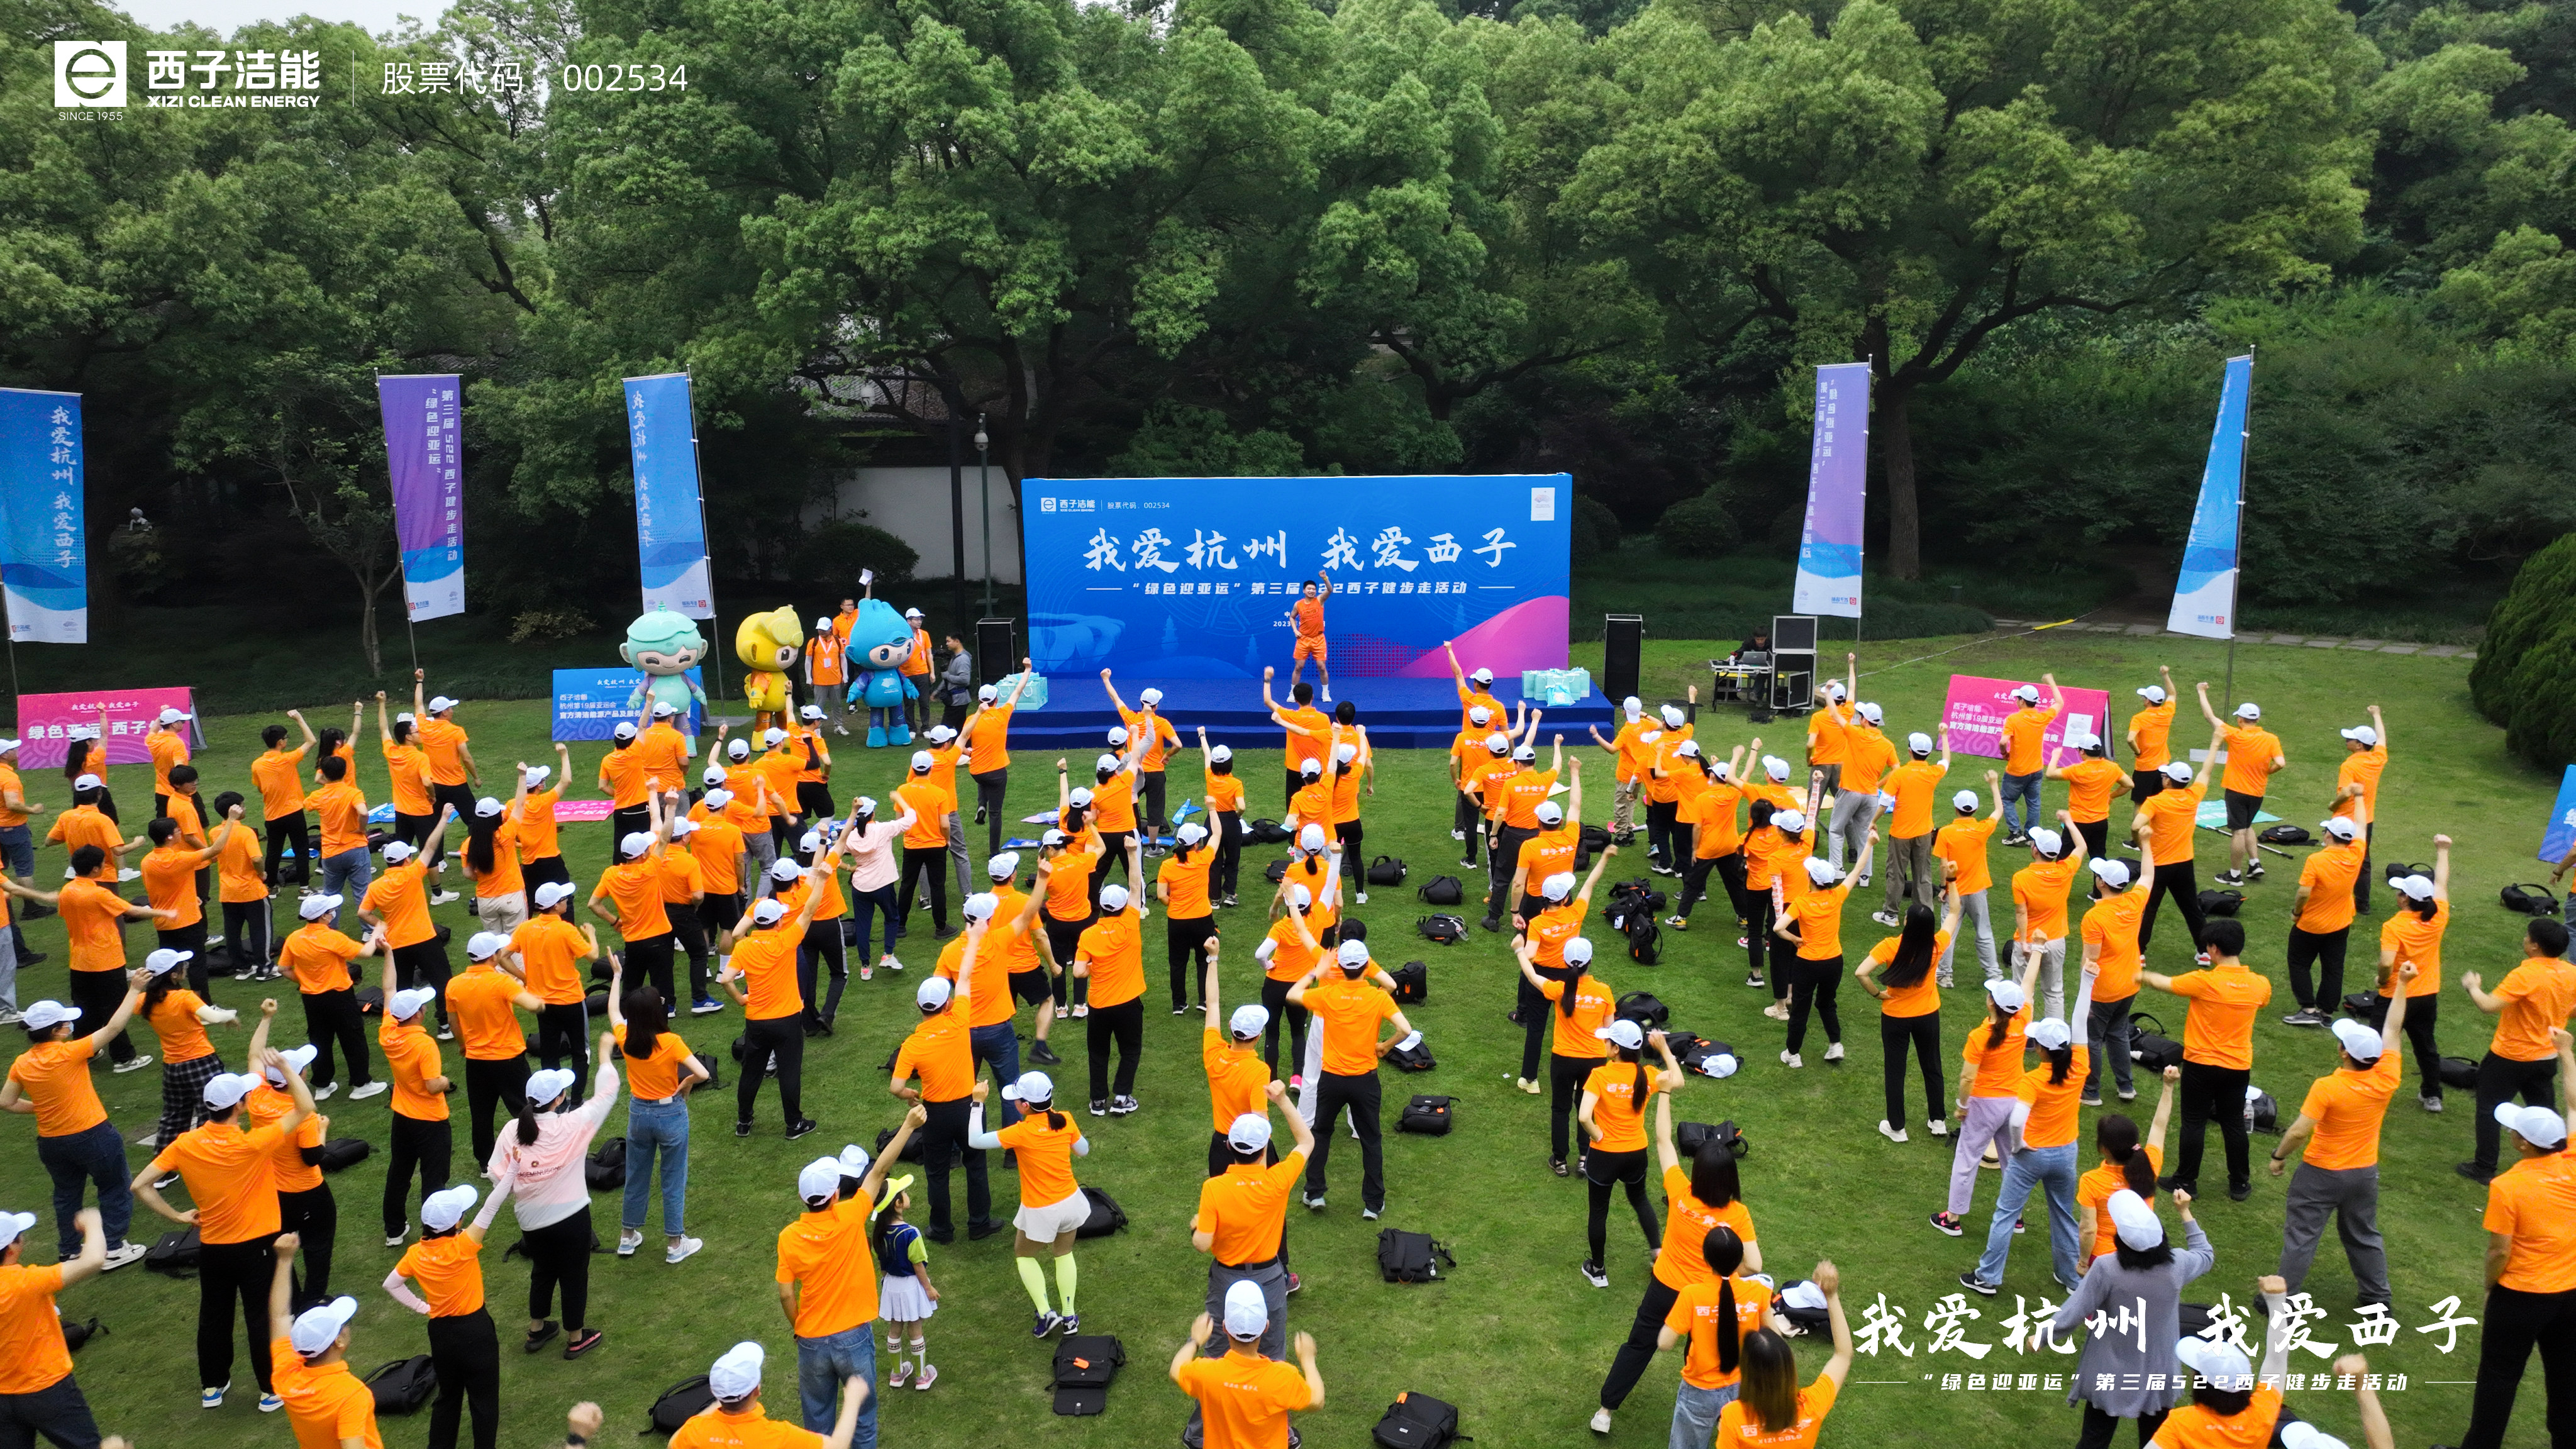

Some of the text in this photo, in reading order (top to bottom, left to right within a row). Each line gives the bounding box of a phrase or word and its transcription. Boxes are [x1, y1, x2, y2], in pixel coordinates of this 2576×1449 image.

[441, 390, 455, 429] 第三届
[51, 406, 77, 569] 我爱杭州 我爱西子
[1060, 499, 1096, 508] 西子洁能
[445, 469, 458, 561] 西子健步走活动
[1083, 526, 1517, 573] 我爱杭州 我爱西子
[1133, 582, 1467, 595] “绿色迎亚运”第三届22西子健步走活动
[71, 702, 97, 711] 我爱杭
[560, 701, 617, 709] 杭州第19届亚运会
[559, 710, 653, 719] 官方清洁能源产品及服务
[1951, 711, 2004, 724] 杭州第19届亚运
